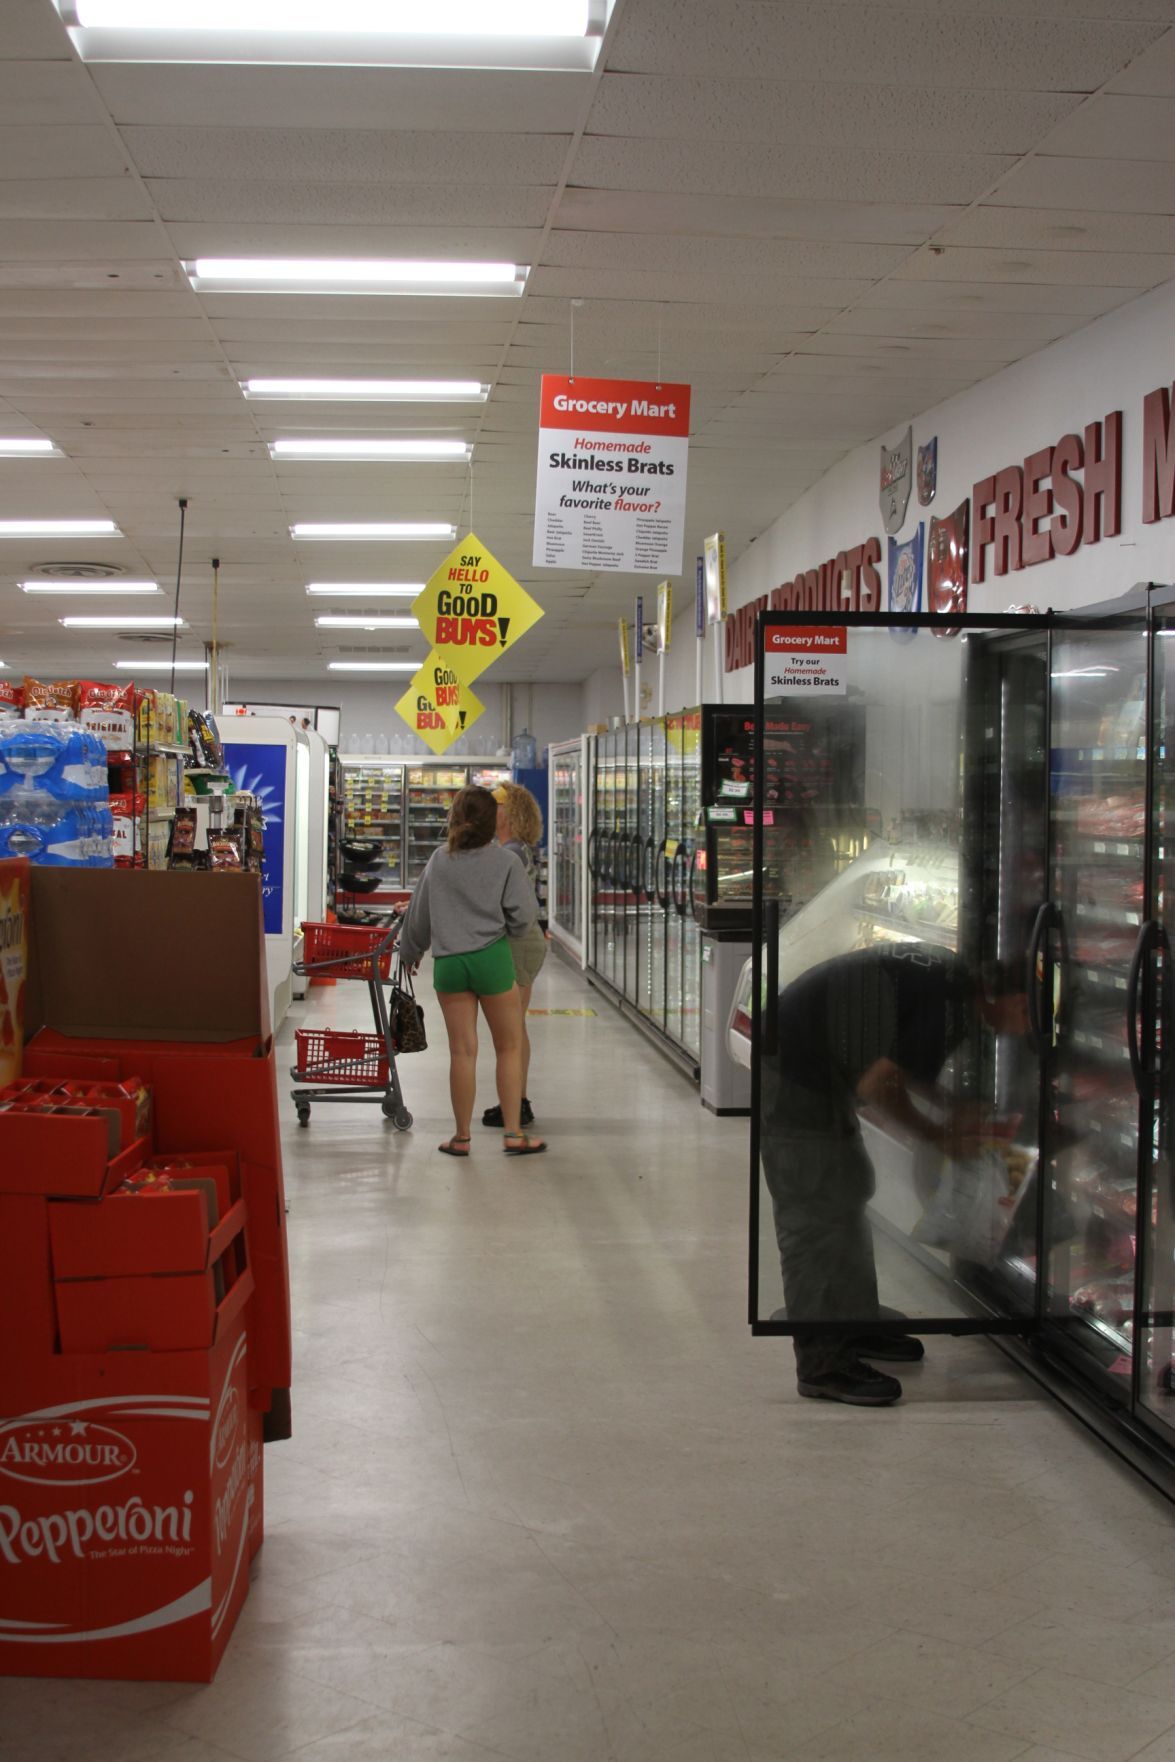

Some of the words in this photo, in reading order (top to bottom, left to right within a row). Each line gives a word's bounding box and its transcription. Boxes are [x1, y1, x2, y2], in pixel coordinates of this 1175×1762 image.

[553, 394, 627, 419] Grocery
[630, 400, 676, 418] Mart
[574, 437, 652, 454] Homemade
[549, 453, 624, 472] Skinless
[627, 458, 675, 475] Brats
[572, 480, 617, 495] What's
[619, 484, 650, 497] your
[971, 410, 1123, 584] FRESH
[559, 495, 612, 511] favorite
[614, 498, 661, 513] flavor?
[460, 555, 482, 567] SAY
[448, 568, 489, 583] HELLO
[459, 583, 473, 594] TO
[437, 590, 498, 617] GOOD
[435, 617, 511, 648] BUYS!
[772, 634, 813, 647] Grocery
[814, 635, 840, 645] Mart
[791, 657, 805, 666] Try
[784, 667, 827, 675] Homemade
[771, 676, 812, 686] Skinless
[813, 677, 840, 686] Brats
[0, 1436, 123, 1466] ARMOUR
